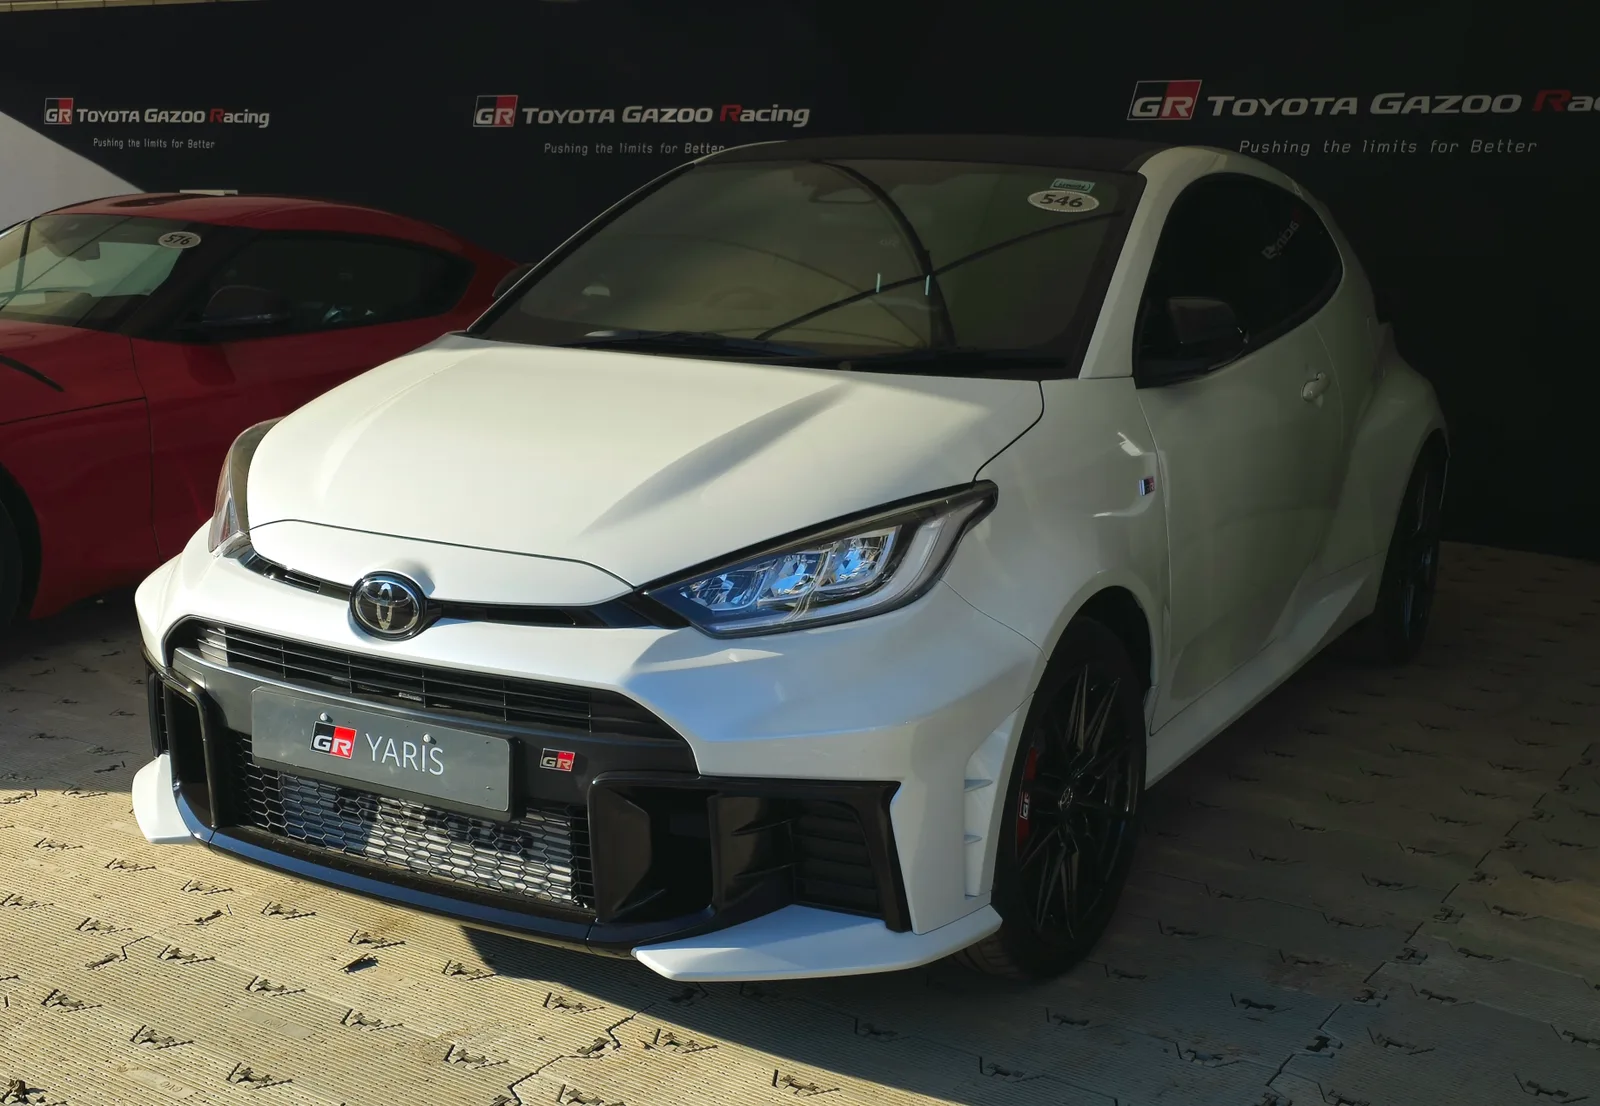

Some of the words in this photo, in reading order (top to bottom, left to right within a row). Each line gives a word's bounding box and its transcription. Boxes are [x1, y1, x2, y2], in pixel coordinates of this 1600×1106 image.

[1131, 96, 1194, 118] GR
[45, 108, 72, 122] GR
[209, 108, 270, 128] Racing
[475, 107, 514, 125] GR
[719, 103, 810, 128] Racing
[93, 137, 124, 150] Pushing
[128, 138, 141, 148] the
[143, 138, 168, 148] limits
[171, 138, 184, 148] for
[187, 138, 215, 149] Better
[544, 142, 589, 156] Pushing
[595, 143, 613, 153] the
[619, 142, 653, 153] limits
[659, 143, 678, 154] for
[684, 143, 725, 154] Better
[1239, 140, 1311, 156] Pushing
[1322, 140, 1351, 153] the
[1362, 139, 1418, 154] limits
[1430, 139, 1459, 153] for
[1470, 139, 1538, 153] Better
[1039, 193, 1083, 208] 546
[164, 234, 192, 245] 576
[312, 734, 352, 757] GR
[365, 732, 444, 776] YARIS
[542, 756, 572, 770] GR
